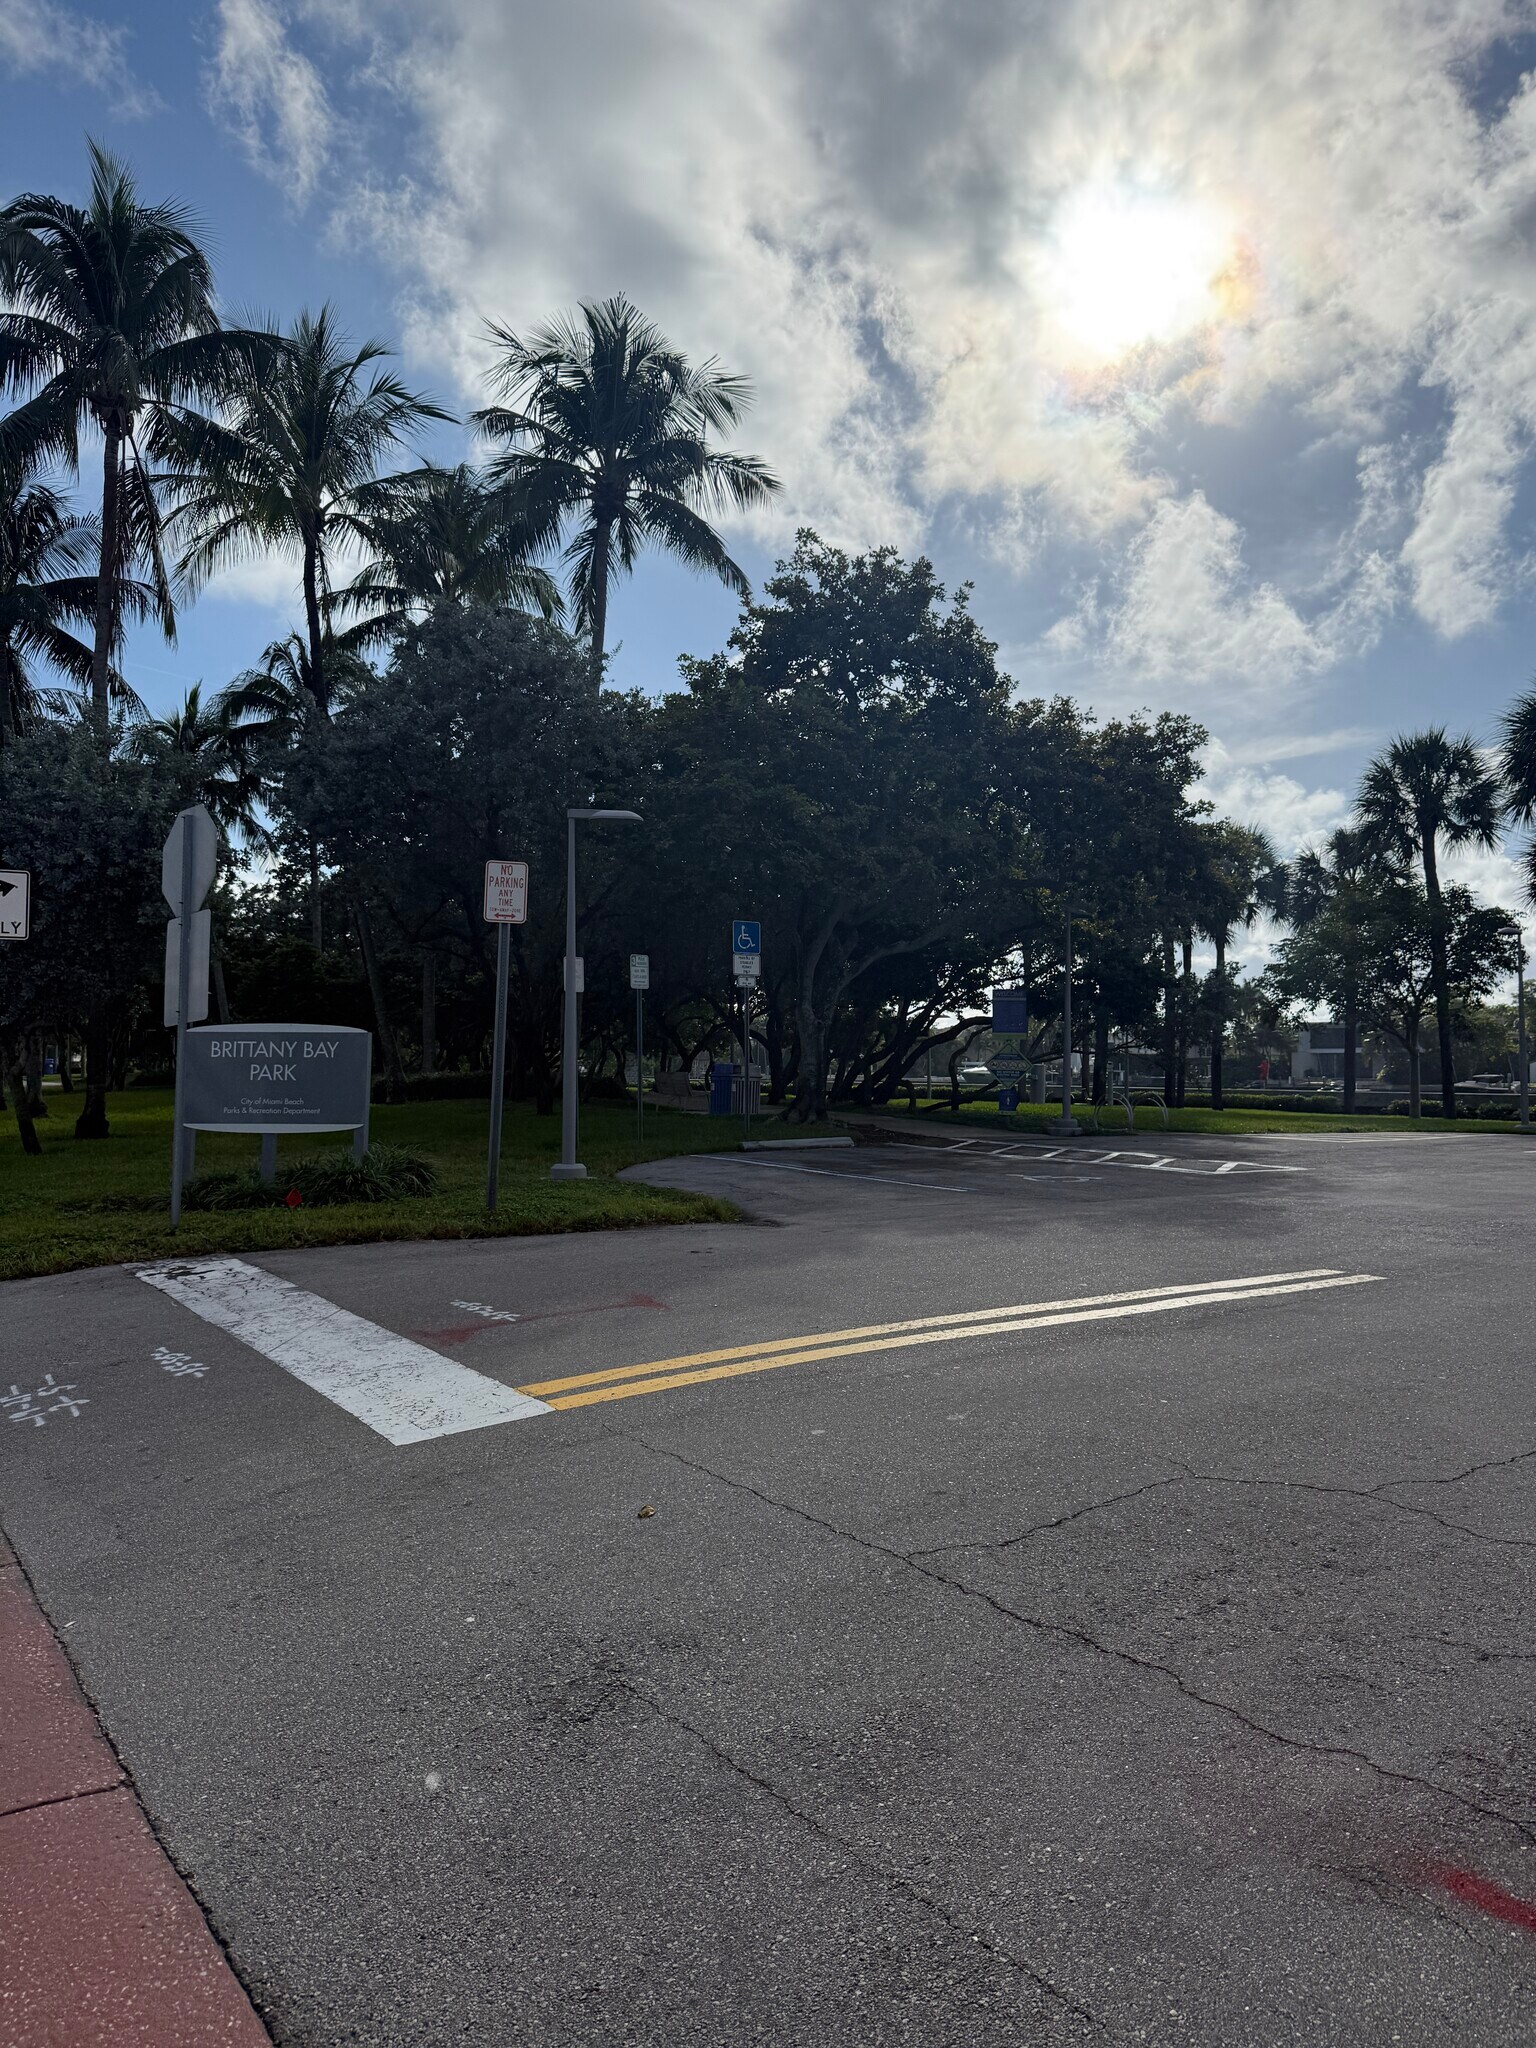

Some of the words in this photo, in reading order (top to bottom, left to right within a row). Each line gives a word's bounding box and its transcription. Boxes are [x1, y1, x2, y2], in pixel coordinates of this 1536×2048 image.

[501, 864, 513, 876] NO
[489, 876, 524, 889] PARKING
[498, 889, 514, 898] ANY
[498, 898, 513, 907] TIME
[0, 921, 22, 934] LY
[210, 1040, 298, 1058] BRITTANY
[303, 1041, 340, 1058] BAY
[250, 1064, 297, 1081] PARK
[240, 1097, 253, 1106] City
[254, 1096, 262, 1105] of
[262, 1097, 283, 1105] Miami
[284, 1097, 305, 1105] Beach
[223, 1106, 241, 1114] Parks
[248, 1106, 282, 1114] Recreation
[283, 1106, 321, 1116] Department
